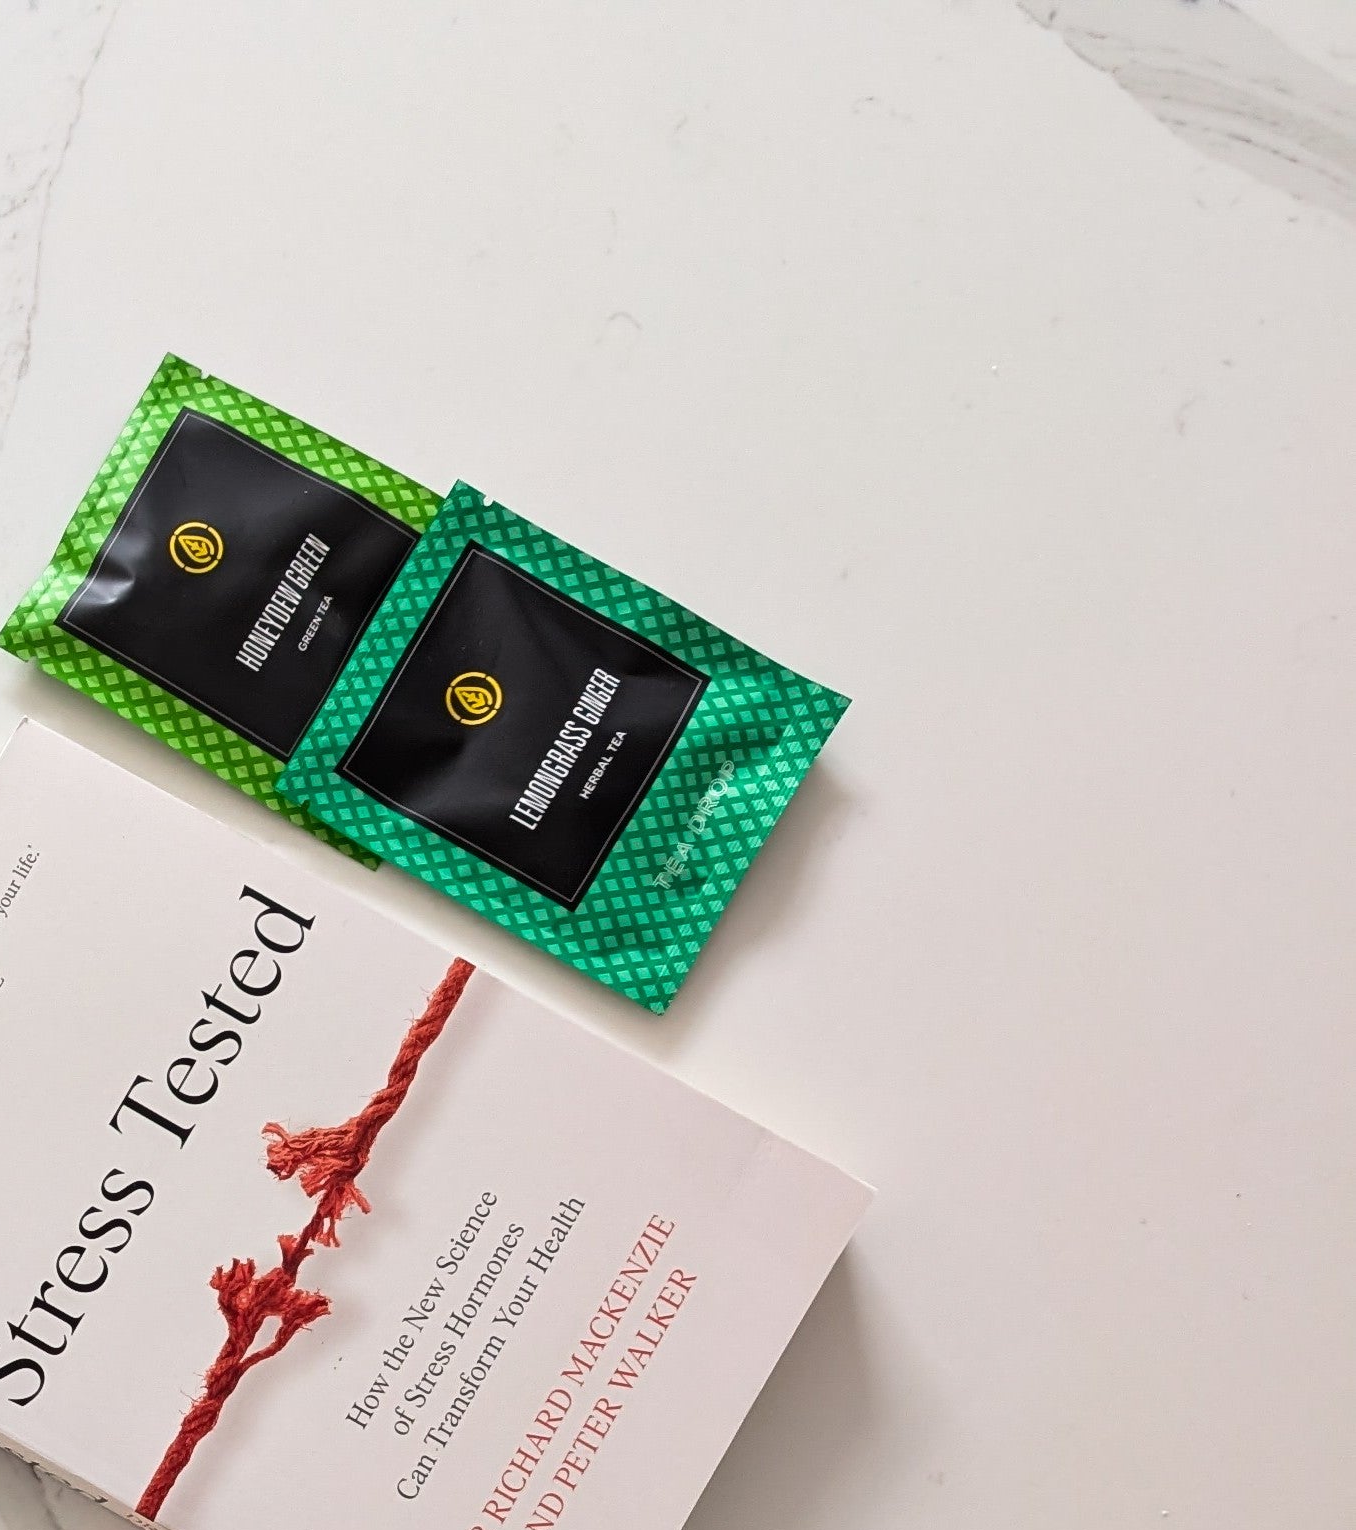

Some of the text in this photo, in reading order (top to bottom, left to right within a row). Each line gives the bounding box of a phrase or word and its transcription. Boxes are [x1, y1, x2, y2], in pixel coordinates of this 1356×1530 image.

[235, 533, 331, 672] HONEYDEW GREEN
[297, 595, 333, 652] GREEN TEA
[509, 668, 621, 831] LEMONGRASS GINGER
[579, 731, 628, 800] HERBAL TEA
[108, 884, 317, 1150] Tested
[345, 1191, 498, 1430] How the New Science
[393, 1223, 525, 1436] of Stress Hormones
[396, 1198, 586, 1500] Can Transform Your Health
[481, 1388, 572, 1525] RICHARD
[560, 1214, 676, 1388] MACKENZIE
[552, 1397, 623, 1492] PETER
[607, 1269, 698, 1389] WALKER
